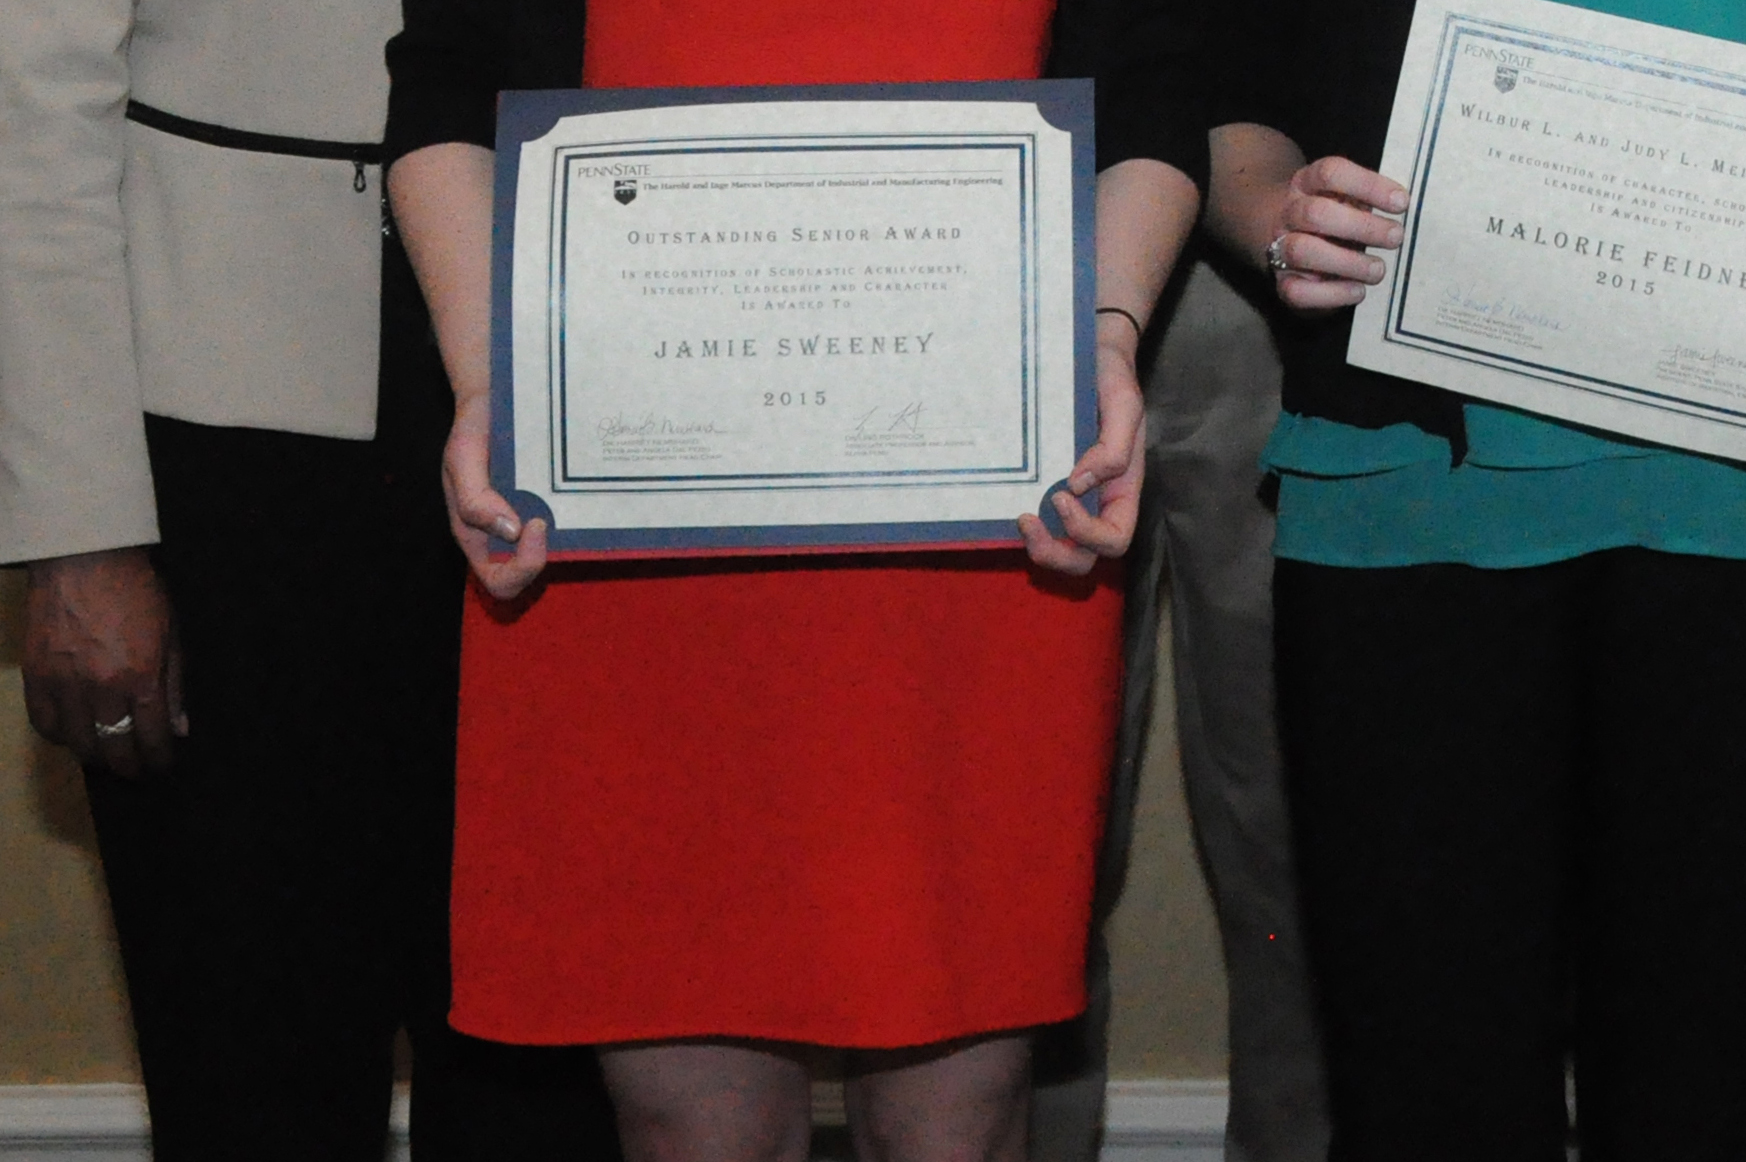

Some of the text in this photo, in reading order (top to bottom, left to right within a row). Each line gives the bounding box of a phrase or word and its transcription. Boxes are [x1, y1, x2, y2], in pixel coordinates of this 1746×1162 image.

[1461, 103, 1531, 131] WILBUR
[1543, 122, 1560, 137] L.
[1574, 132, 1609, 148] AND
[1621, 140, 1669, 161] JUDY
[1680, 152, 1698, 167] L.
[661, 182, 691, 190] Harold
[692, 181, 709, 189] and
[711, 181, 729, 191] Inge
[731, 180, 762, 188] Marcus
[764, 178, 815, 190] Department
[817, 177, 827, 187] of
[828, 177, 870, 186] Industrial
[871, 177, 888, 186] and
[889, 176, 951, 188] Manufacturing
[952, 175, 1004, 187] Engineering
[1488, 147, 1501, 159] IN
[1509, 154, 1594, 179] RECOGNITION
[1602, 174, 1617, 184] OF
[1624, 178, 1705, 204] CHARACTER,
[1544, 178, 1745, 228] LEADERSHIP AND CITIZENSHIP
[628, 227, 961, 244] OUTSTANDING SENIOR AWARD
[1486, 216, 1625, 262] MALORIE
[622, 265, 968, 279] IN RECOGNITION OF SCHOLASTIC ACHIEVEMENT,
[1596, 271, 1655, 295] 2015
[643, 282, 948, 295] INTEGRITY, LEADERSHIP AND CHARACTER
[654, 332, 934, 358] JAMIE SWEENEY
[763, 391, 827, 407] 2015
